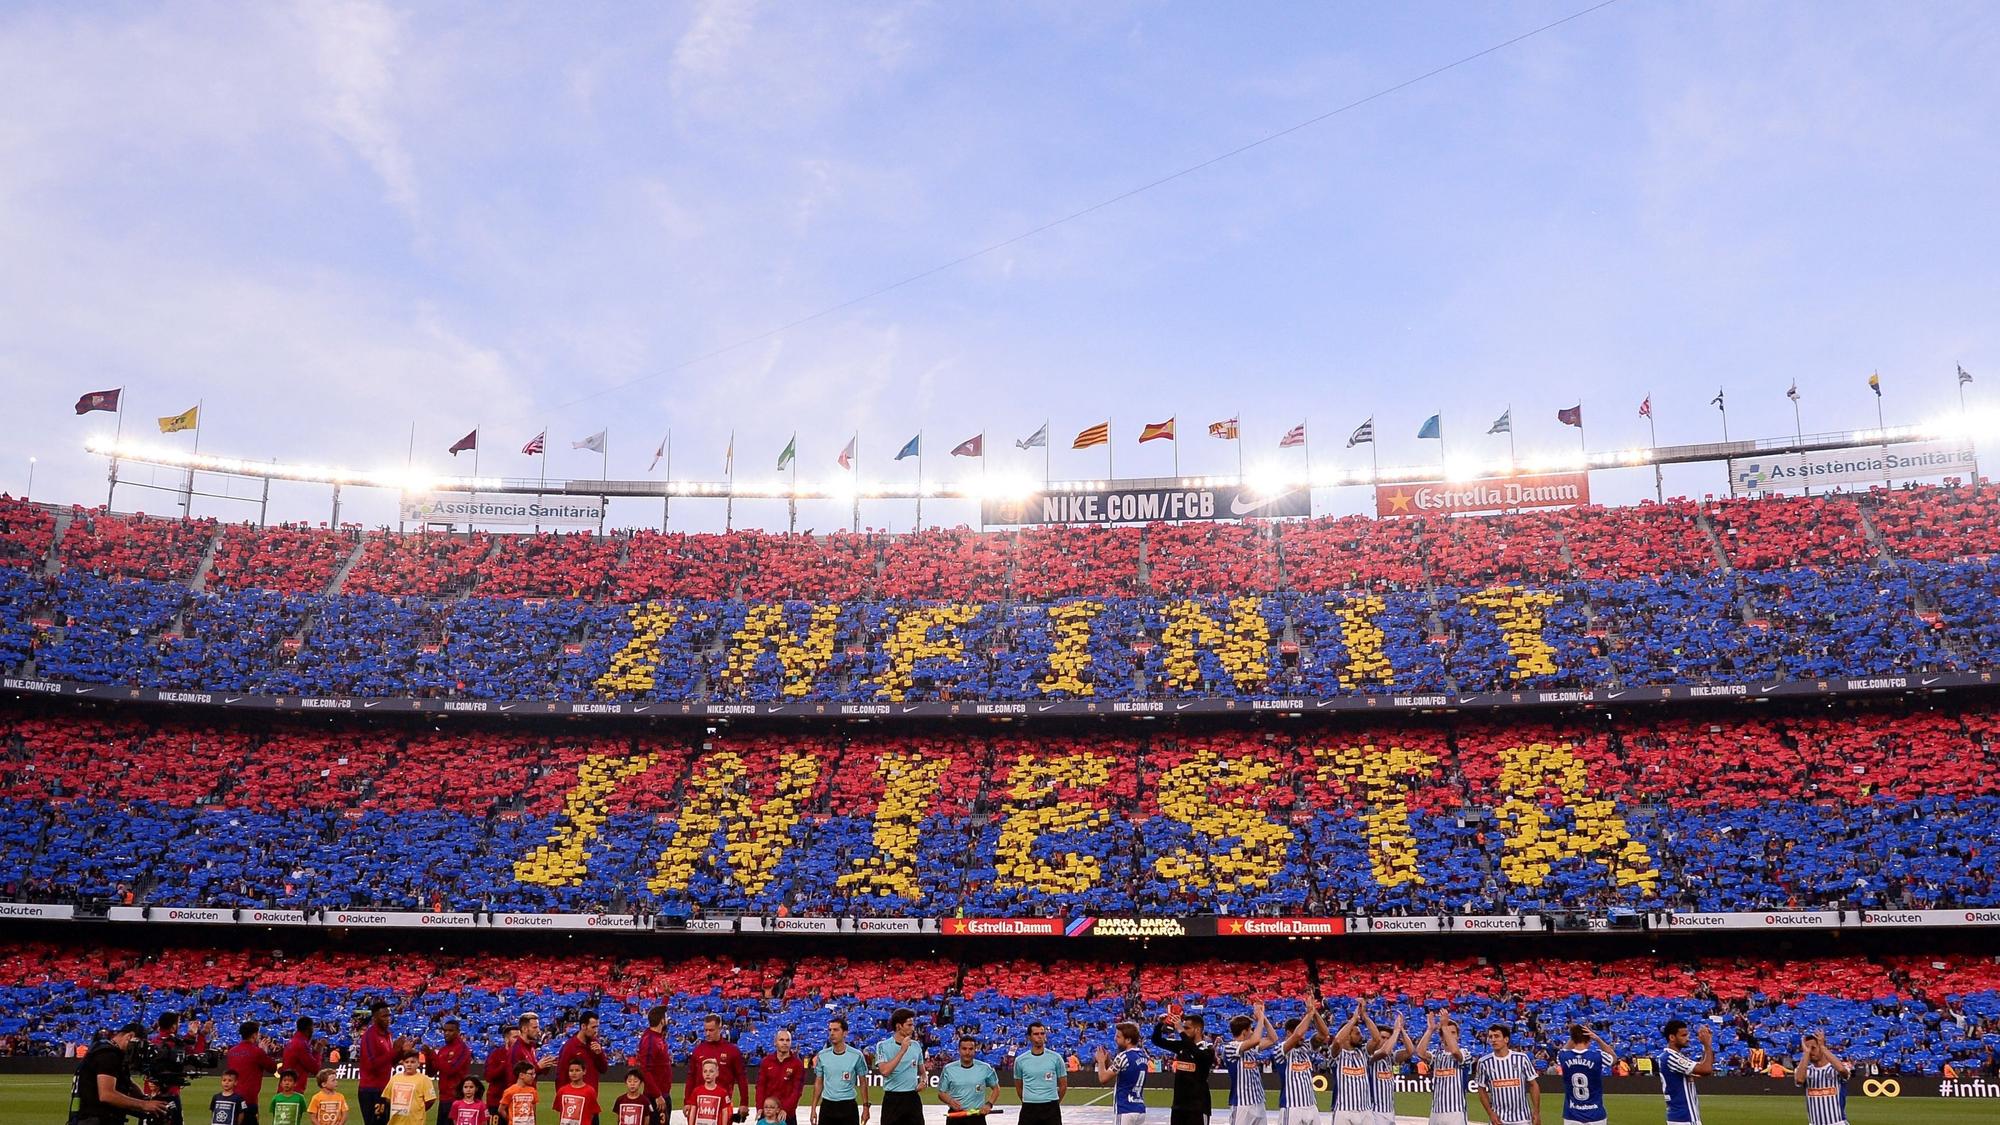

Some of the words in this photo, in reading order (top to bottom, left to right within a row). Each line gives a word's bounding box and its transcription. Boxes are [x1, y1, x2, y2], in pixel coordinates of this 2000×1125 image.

[1771, 457, 1882, 480] Assistència
[1886, 448, 1975, 468] Sanitària
[1414, 486, 1502, 510] Estrella
[1503, 483, 1580, 505] Damm
[432, 500, 526, 516] Assistència
[528, 503, 600, 518] Sanitària
[1043, 491, 1214, 522] NIKE.COM/FCB
[4, 679, 62, 693] NIKE.COM/FCB
[1848, 677, 1907, 690] NIKE.COM/FCB
[1690, 685, 1747, 697] NIKE.COM/FCB
[158, 691, 212, 703] NIKE.COM/FCB
[1394, 696, 1447, 707] NIKE.COM/FCB
[301, 698, 351, 709] NIKE.COM/FCB
[572, 704, 622, 714] NIKE.COM/FCB
[706, 703, 756, 714] NIKE.COM/FCB
[976, 703, 1026, 714] NIKE.COM/FCB
[1113, 701, 1164, 712] NIKE.COM/FCB
[841, 705, 891, 715] NIKE.COM/FCB
[177, 910, 219, 921] Rakuten
[262, 912, 303, 922] Rakuten
[346, 914, 387, 925] Rakuten
[429, 915, 470, 926] Rakuten
[512, 916, 553, 926] Rakuten
[1678, 915, 1725, 926] Rakuten
[1776, 914, 1822, 925] Rakuten
[1873, 912, 1922, 923] Rakuten
[785, 919, 826, 930] Rakuten
[868, 920, 909, 931] Rakuten
[968, 920, 1013, 934] Estrella
[1014, 920, 1052, 934] Damm
[1244, 920, 1291, 934] Estrella
[1292, 920, 1331, 933] Damm
[1383, 919, 1427, 930] Rakuten
[1474, 918, 1518, 929] Rakuten
[1571, 1072, 1590, 1102] 8
